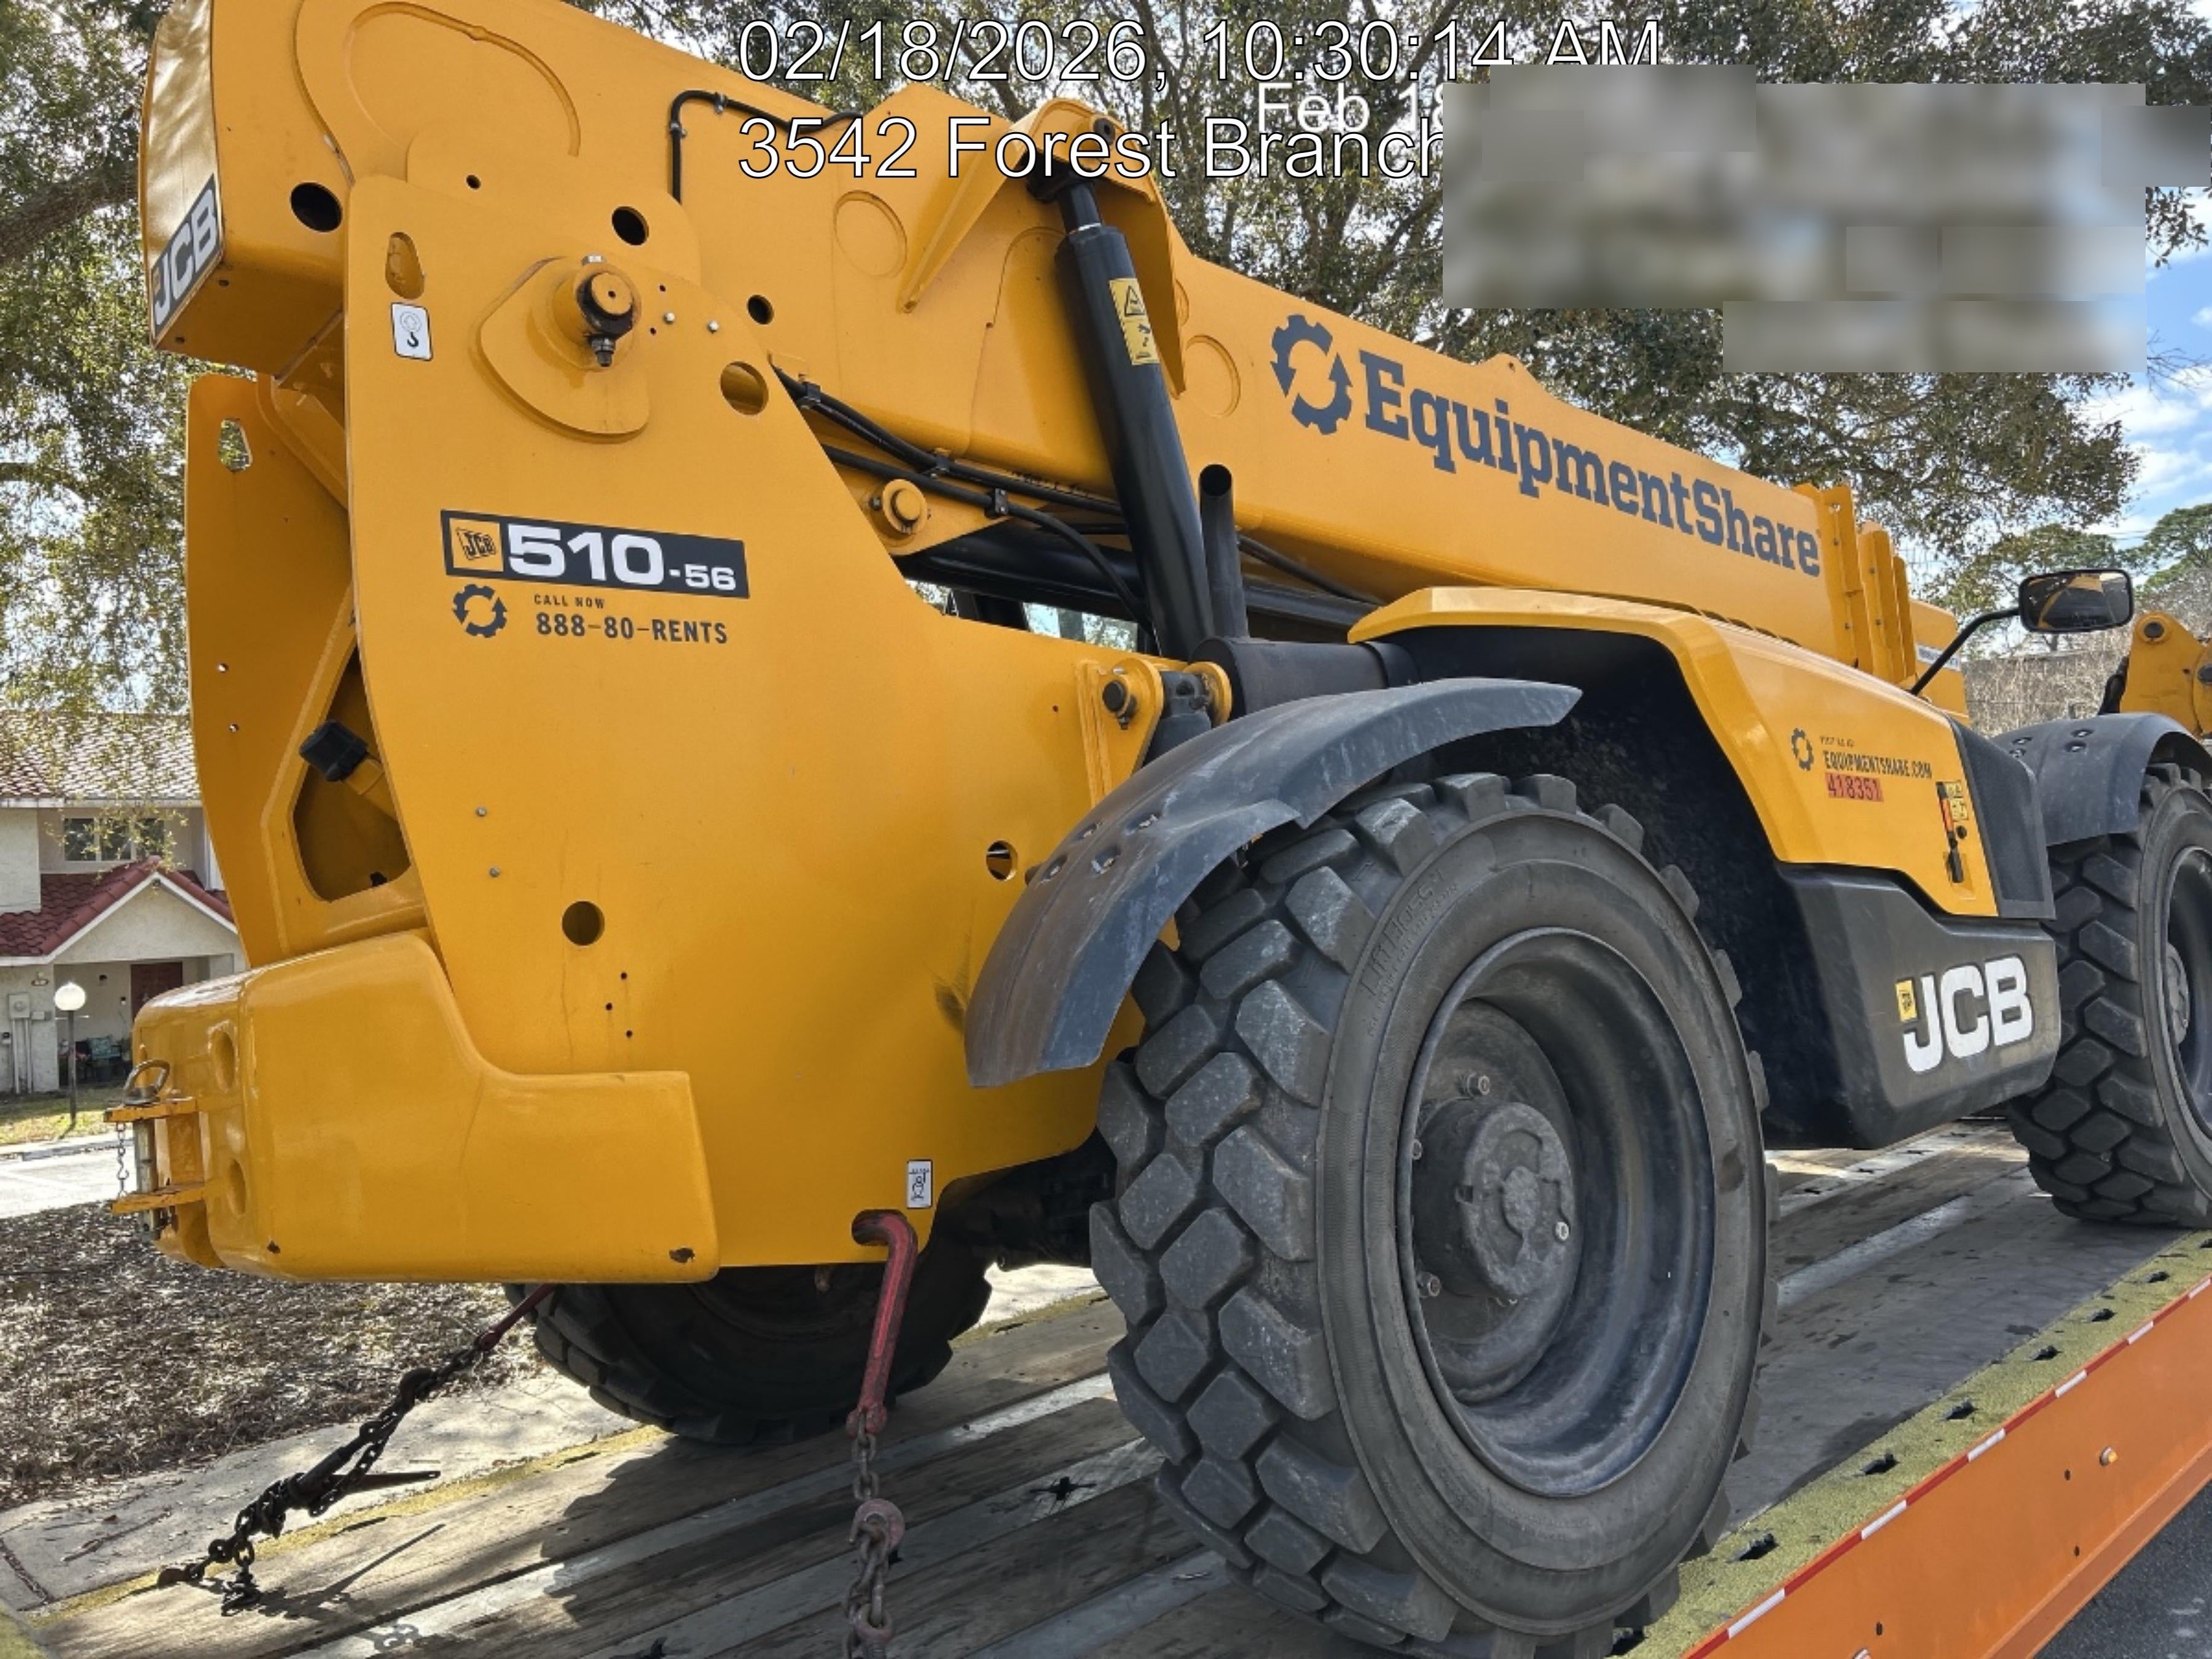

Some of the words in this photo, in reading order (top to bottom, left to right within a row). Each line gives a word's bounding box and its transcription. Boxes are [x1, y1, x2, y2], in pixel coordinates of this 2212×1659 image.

[154, 189, 217, 326] JCB
[1359, 349, 1821, 578] EquipmentShare
[461, 530, 495, 558] JCB
[534, 594, 569, 607] CALL
[575, 597, 605, 609] NOW
[536, 612, 728, 644] 888-80-RENTS
[1903, 957, 2032, 1073] JCB
